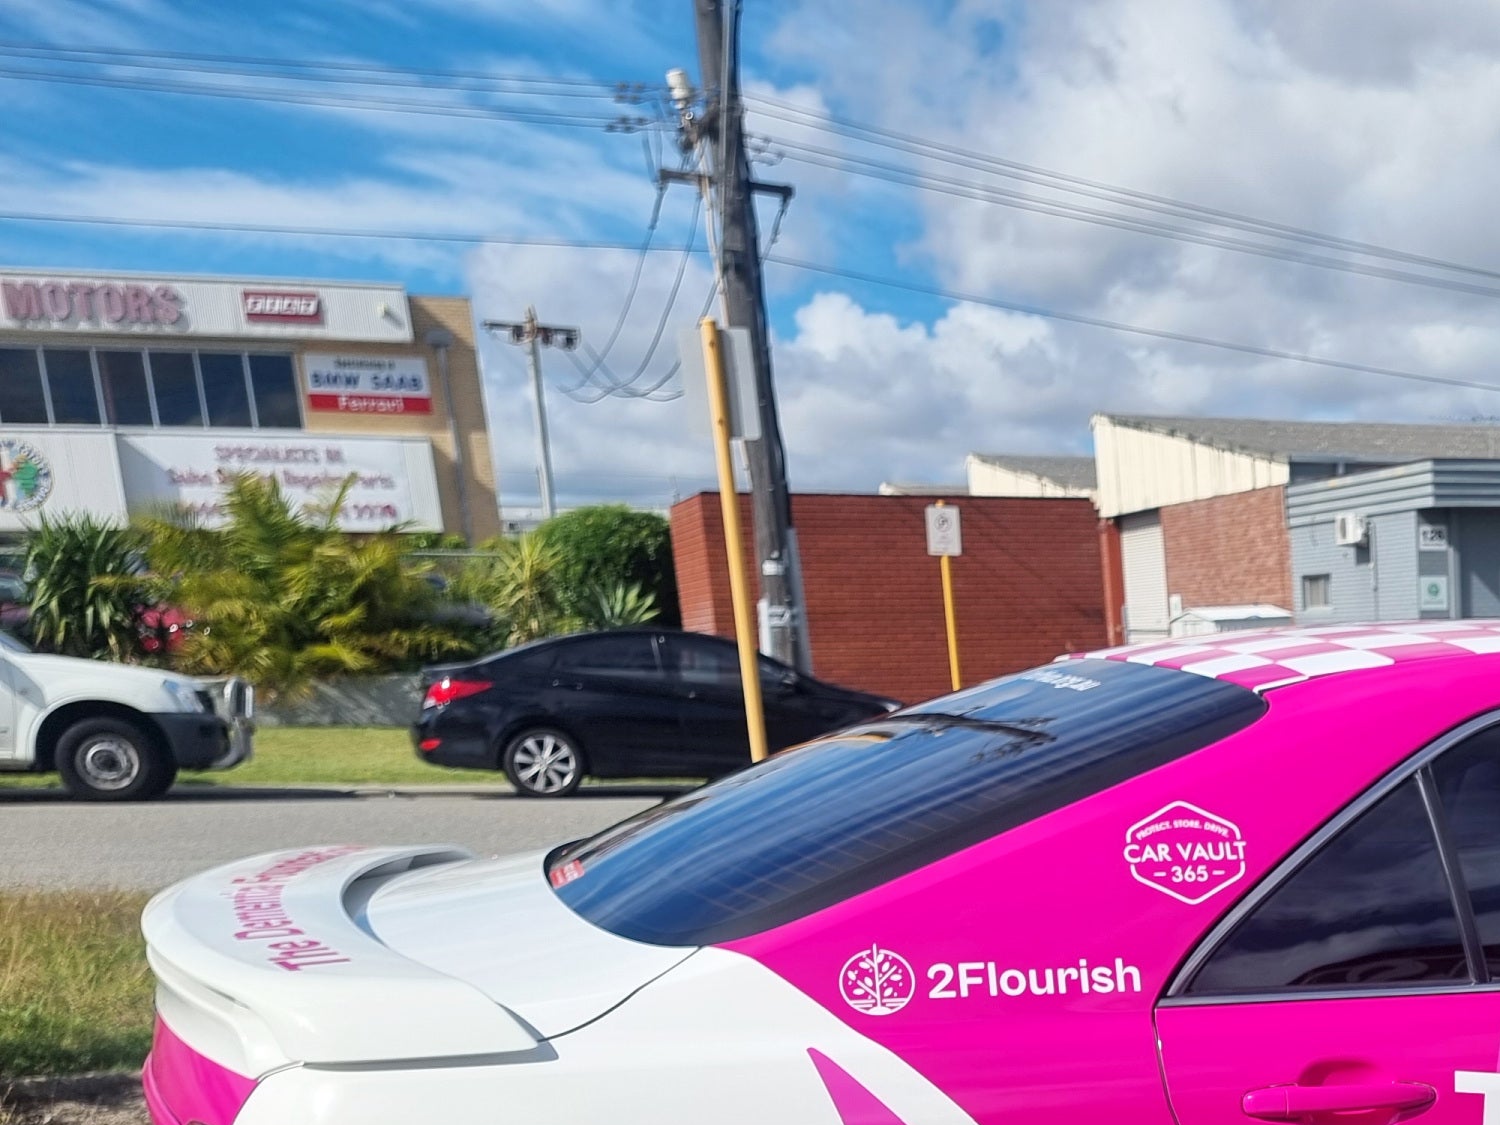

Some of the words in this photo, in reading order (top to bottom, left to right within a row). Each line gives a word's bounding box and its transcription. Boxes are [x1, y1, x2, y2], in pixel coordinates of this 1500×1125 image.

[0, 278, 182, 325] MOTORS
[310, 371, 360, 388] BMW
[371, 373, 423, 391] SAAB
[338, 394, 405, 413] Ferrari
[1123, 843, 1172, 864] CAR
[1175, 841, 1247, 861] VAULT
[1171, 865, 1209, 883] 365
[926, 957, 1142, 999] 2Flourish
